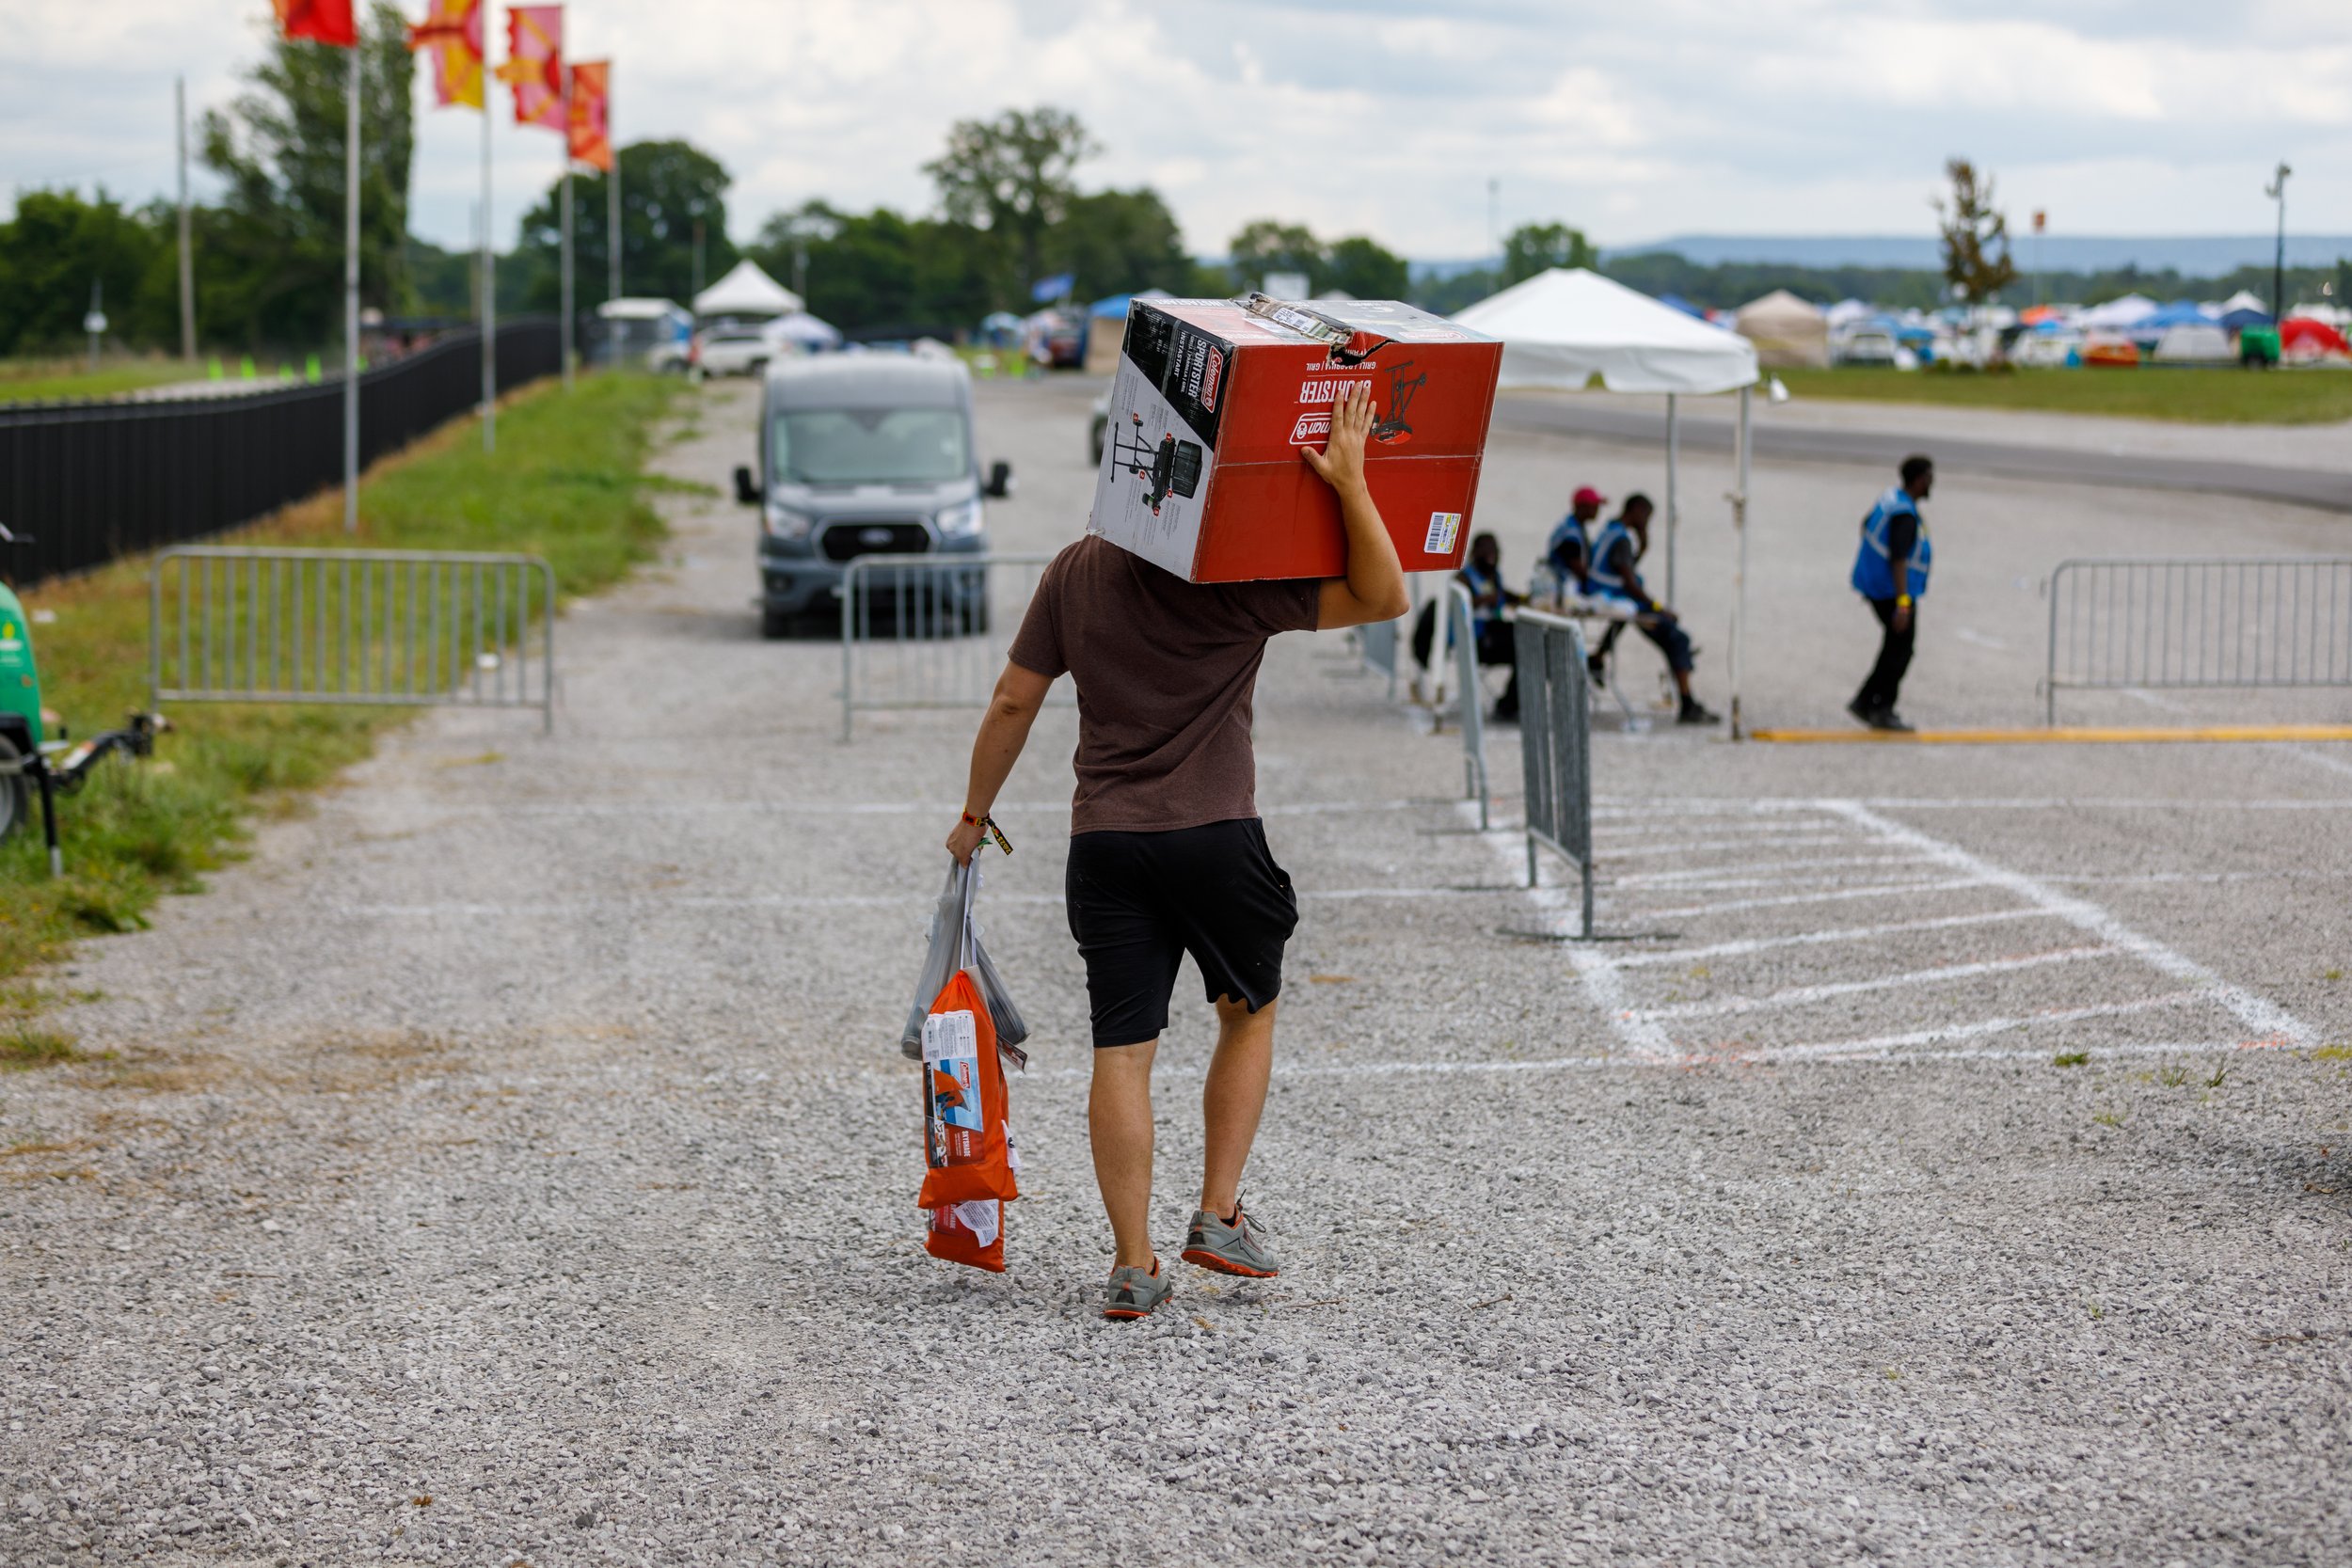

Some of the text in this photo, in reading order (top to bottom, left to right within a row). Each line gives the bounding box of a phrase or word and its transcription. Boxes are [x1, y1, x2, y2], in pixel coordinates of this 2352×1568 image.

[1174, 331, 1185, 377] INSTASTART
[1187, 339, 1206, 398] SPORTSTER
[1206, 353, 1221, 398] Coleman
[1306, 362, 1320, 371] GRIL
